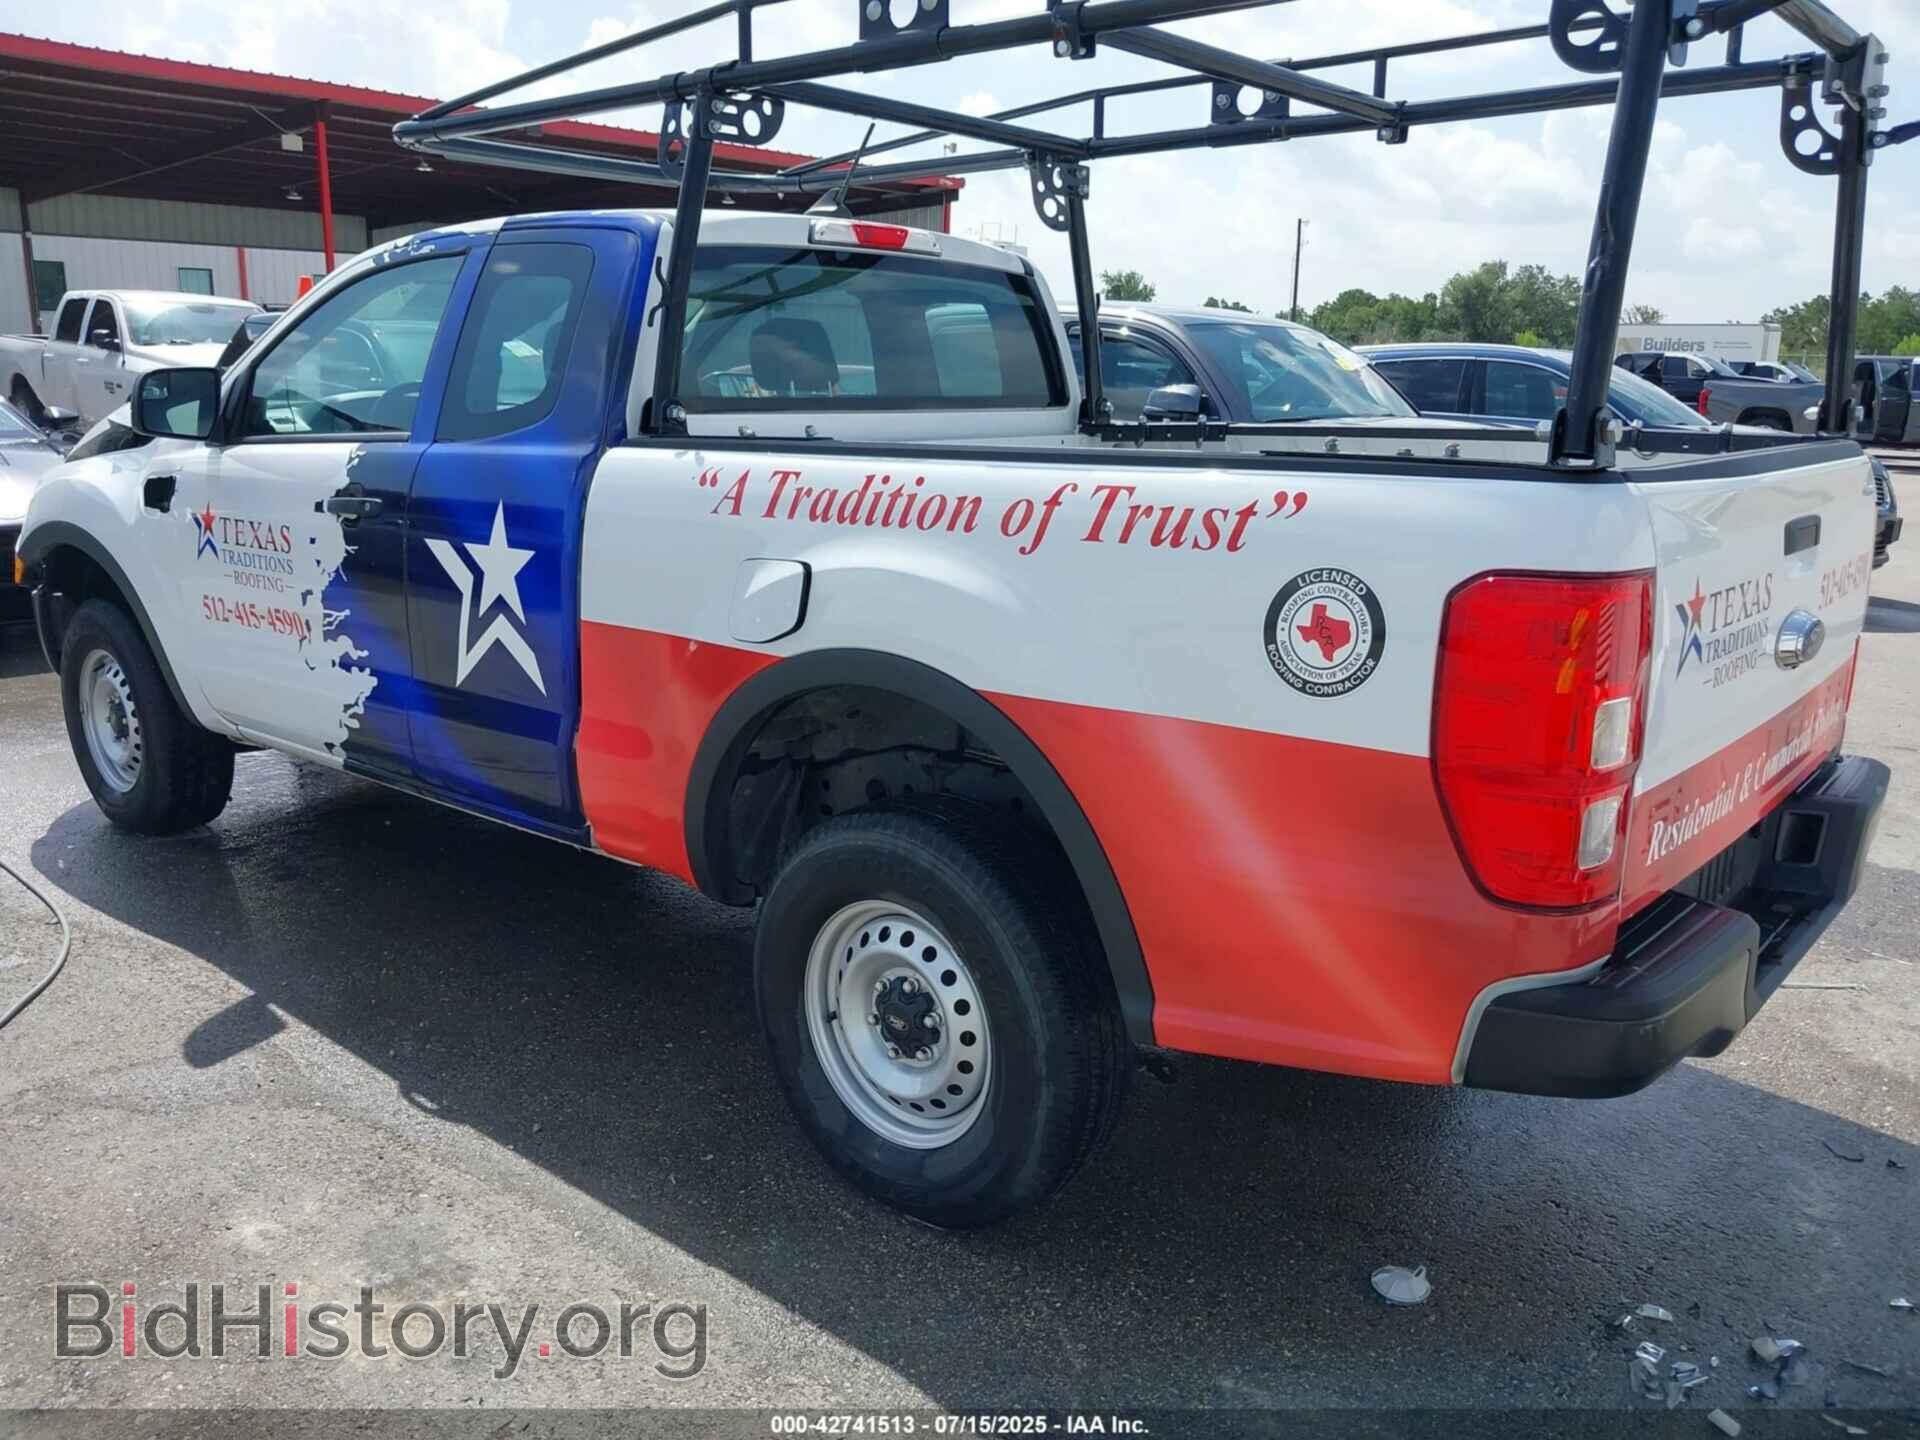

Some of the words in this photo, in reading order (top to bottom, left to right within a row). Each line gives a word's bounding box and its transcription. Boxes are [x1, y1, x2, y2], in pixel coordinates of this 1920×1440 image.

[1643, 337, 1705, 352] Builders
[219, 516, 292, 554] TEXAS
[760, 469, 984, 534] Tradition
[1000, 482, 1077, 556] of
[221, 549, 294, 575] TRADITIONS
[1296, 569, 1367, 596] LICENSED
[203, 594, 306, 639] 512-415-4590
[1281, 587, 1315, 624] ROOFING
[1317, 585, 1369, 635] CONTRACTORS
[1710, 572, 1773, 633] TEXAS
[1279, 639, 1324, 680] ASSOCIATION
[1325, 669, 1337, 680] OF
[1706, 616, 1770, 664] TRADITIONS
[1267, 643, 1303, 688] ROOFING
[1305, 658, 1377, 695] CONTRACTOR
[1646, 770, 1741, 867] Residential
[1739, 762, 1753, 804] &
